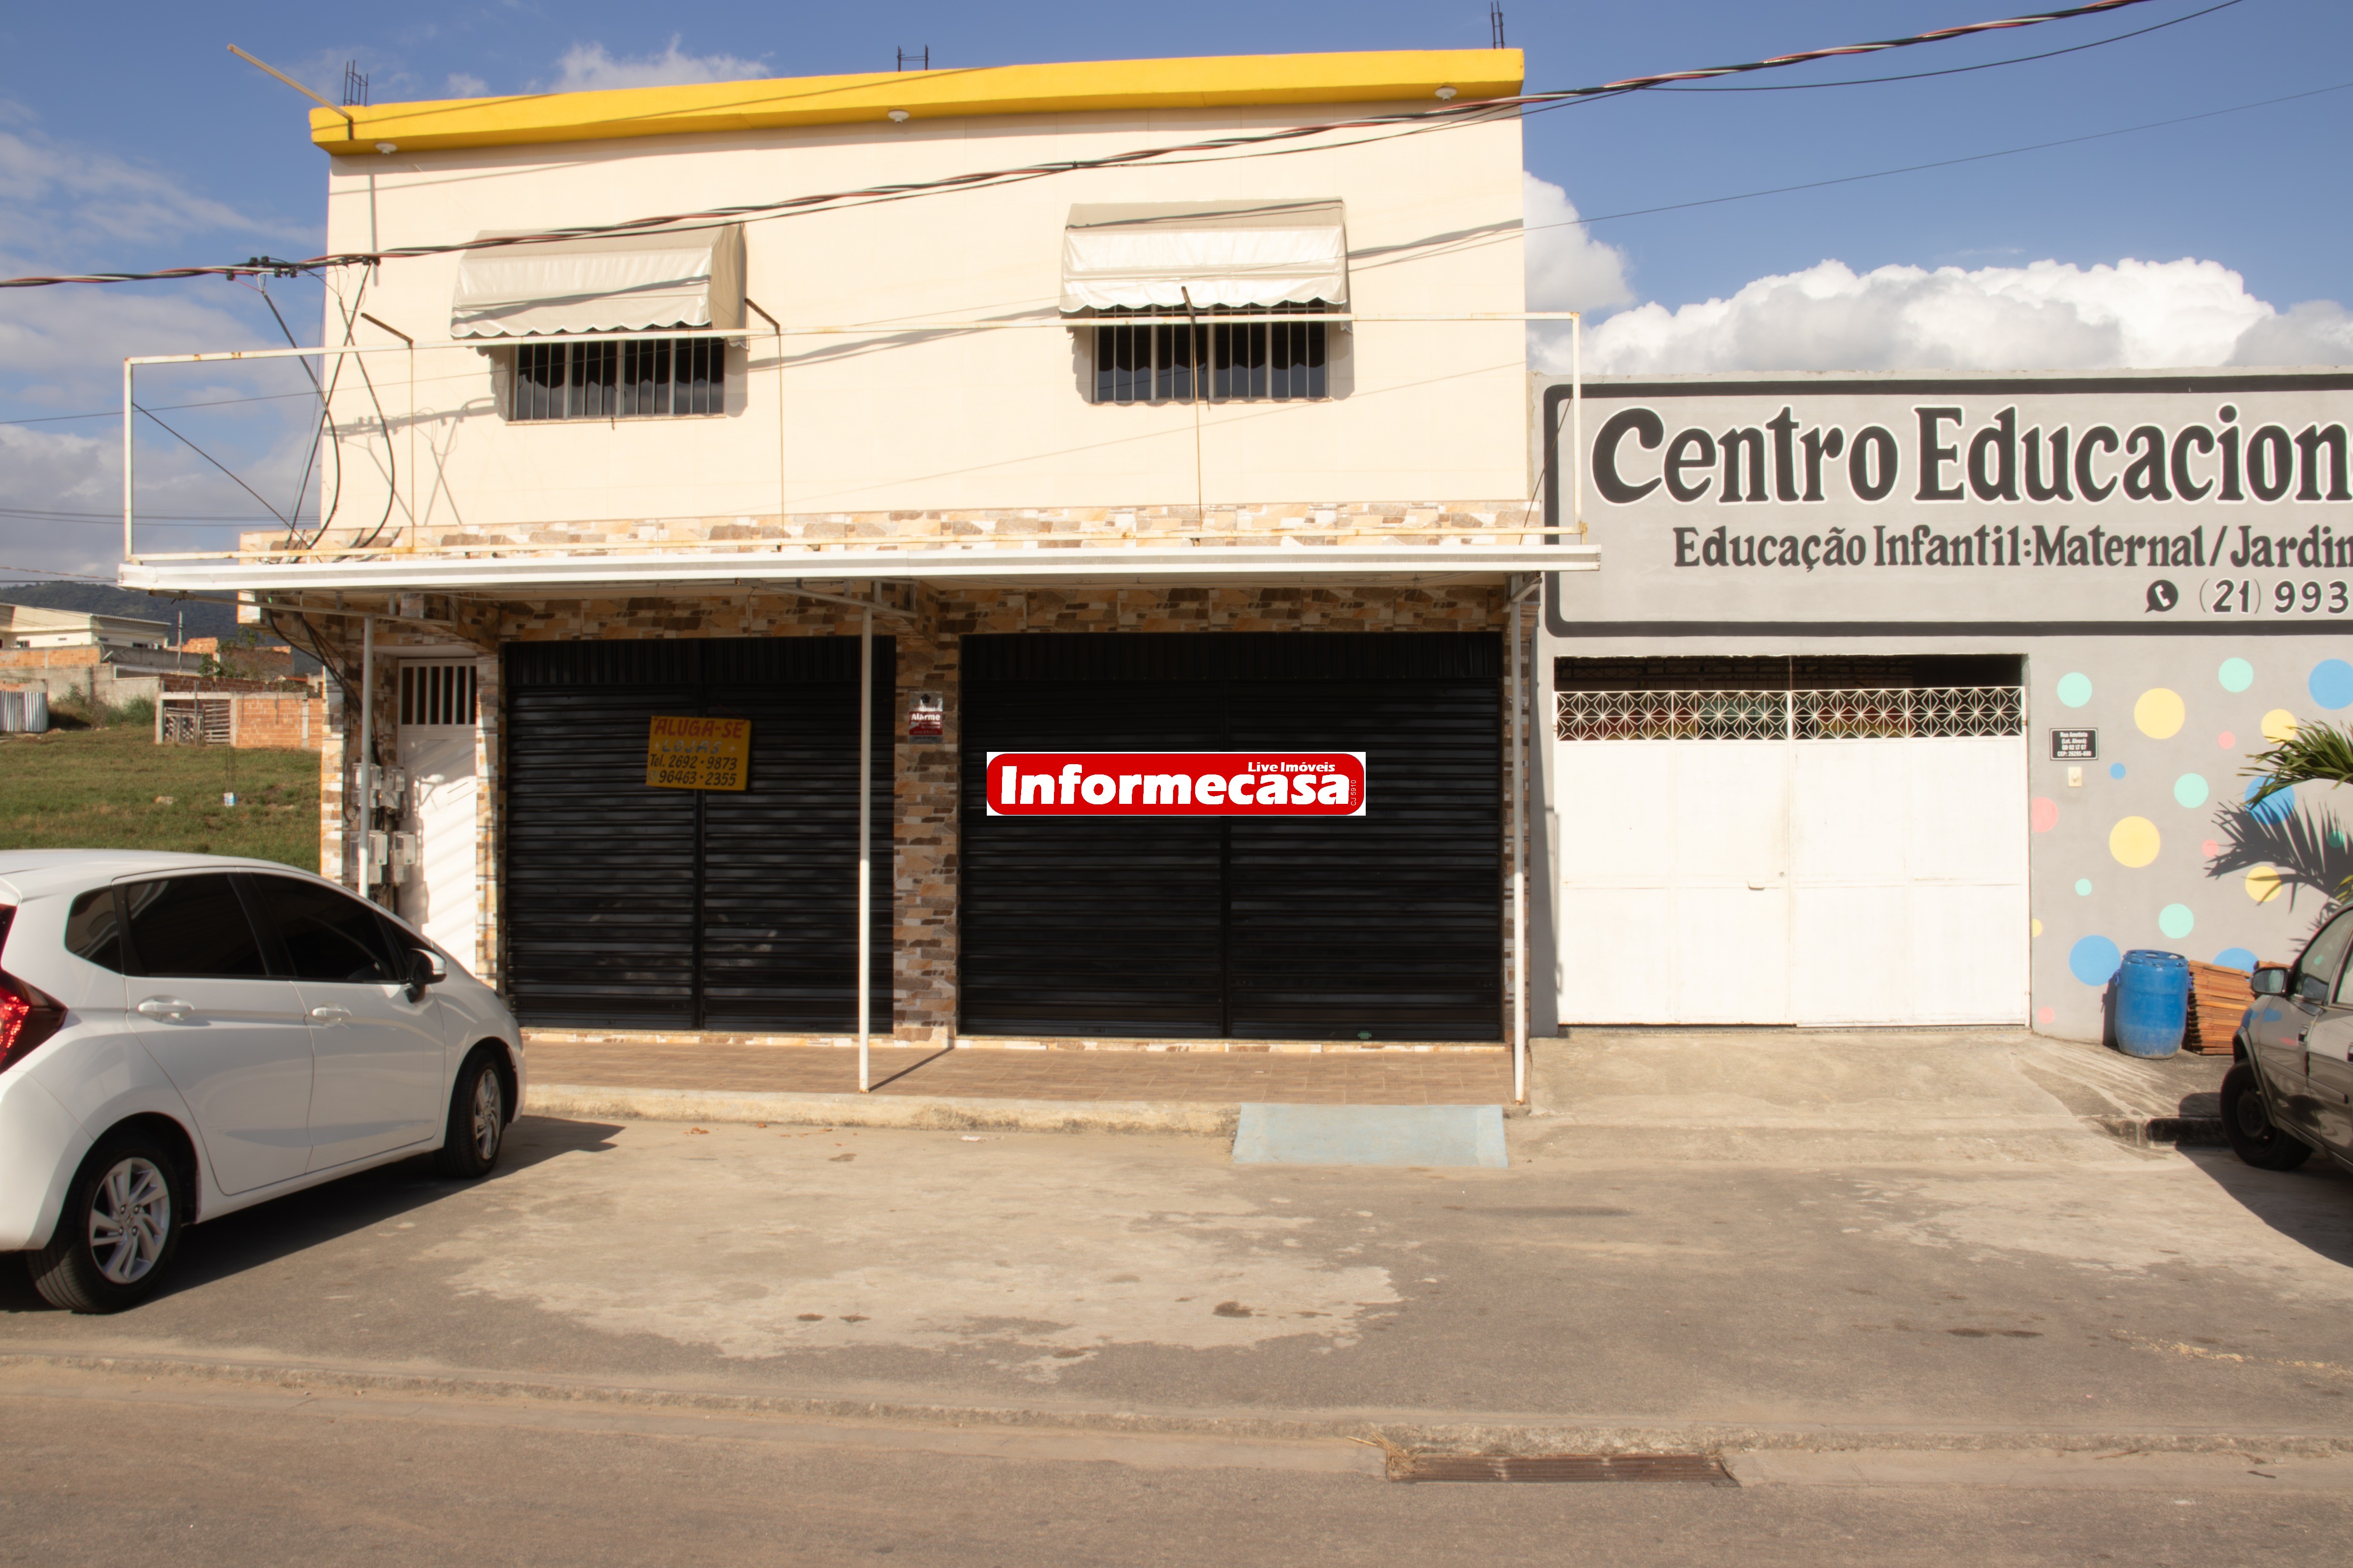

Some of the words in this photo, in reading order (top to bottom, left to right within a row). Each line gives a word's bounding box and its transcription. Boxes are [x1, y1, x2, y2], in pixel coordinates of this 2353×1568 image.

[1592, 406, 1899, 504] Centro
[1673, 526, 1866, 572] Educação
[2200, 578, 2261, 615] (21)
[653, 718, 745, 739] ALUGA-SE
[650, 754, 665, 768] Tel.
[662, 739, 722, 754] LOJAS
